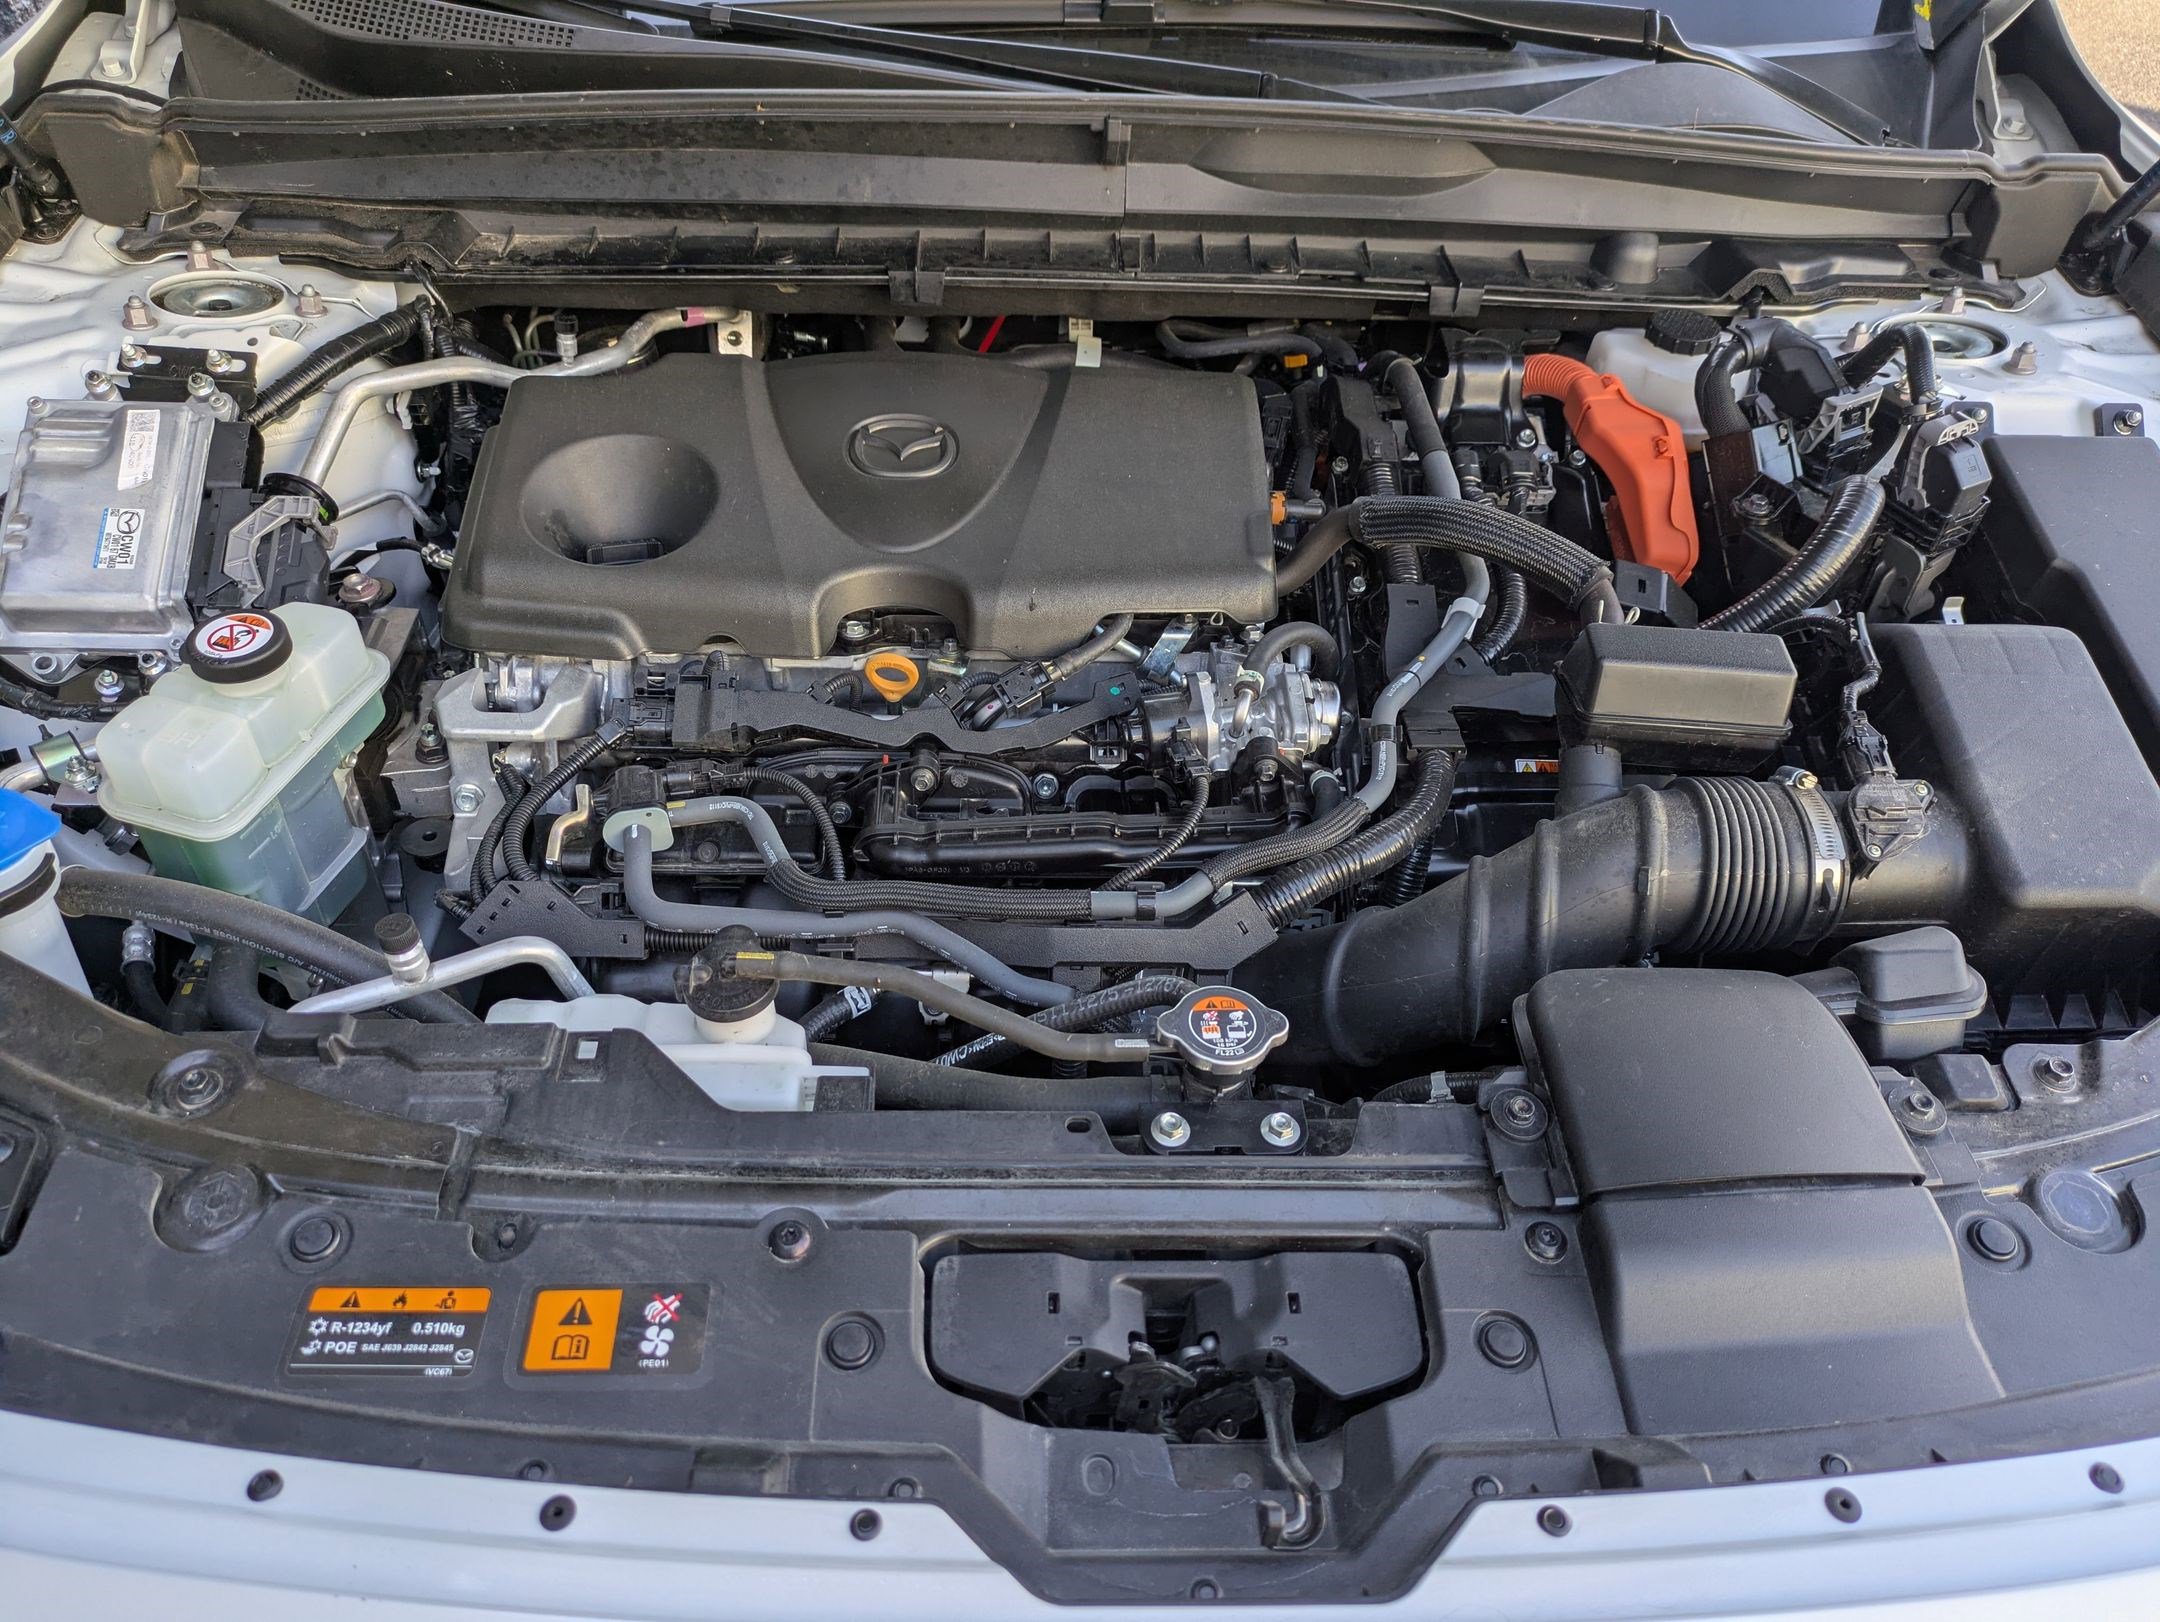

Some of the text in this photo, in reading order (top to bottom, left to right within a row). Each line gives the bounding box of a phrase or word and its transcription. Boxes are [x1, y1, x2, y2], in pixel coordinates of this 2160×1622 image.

[116, 535, 134, 564] CW01
[213, 929, 240, 942] HOSE
[242, 938, 285, 959] SUCTION
[330, 1321, 465, 1337] R-1234yf 0.510kg
[324, 1341, 357, 1354] POE
[361, 1343, 380, 1352] SAE
[381, 1343, 402, 1352] J639
[403, 1343, 428, 1352] J2842
[638, 1359, 670, 1368] (PE01)
